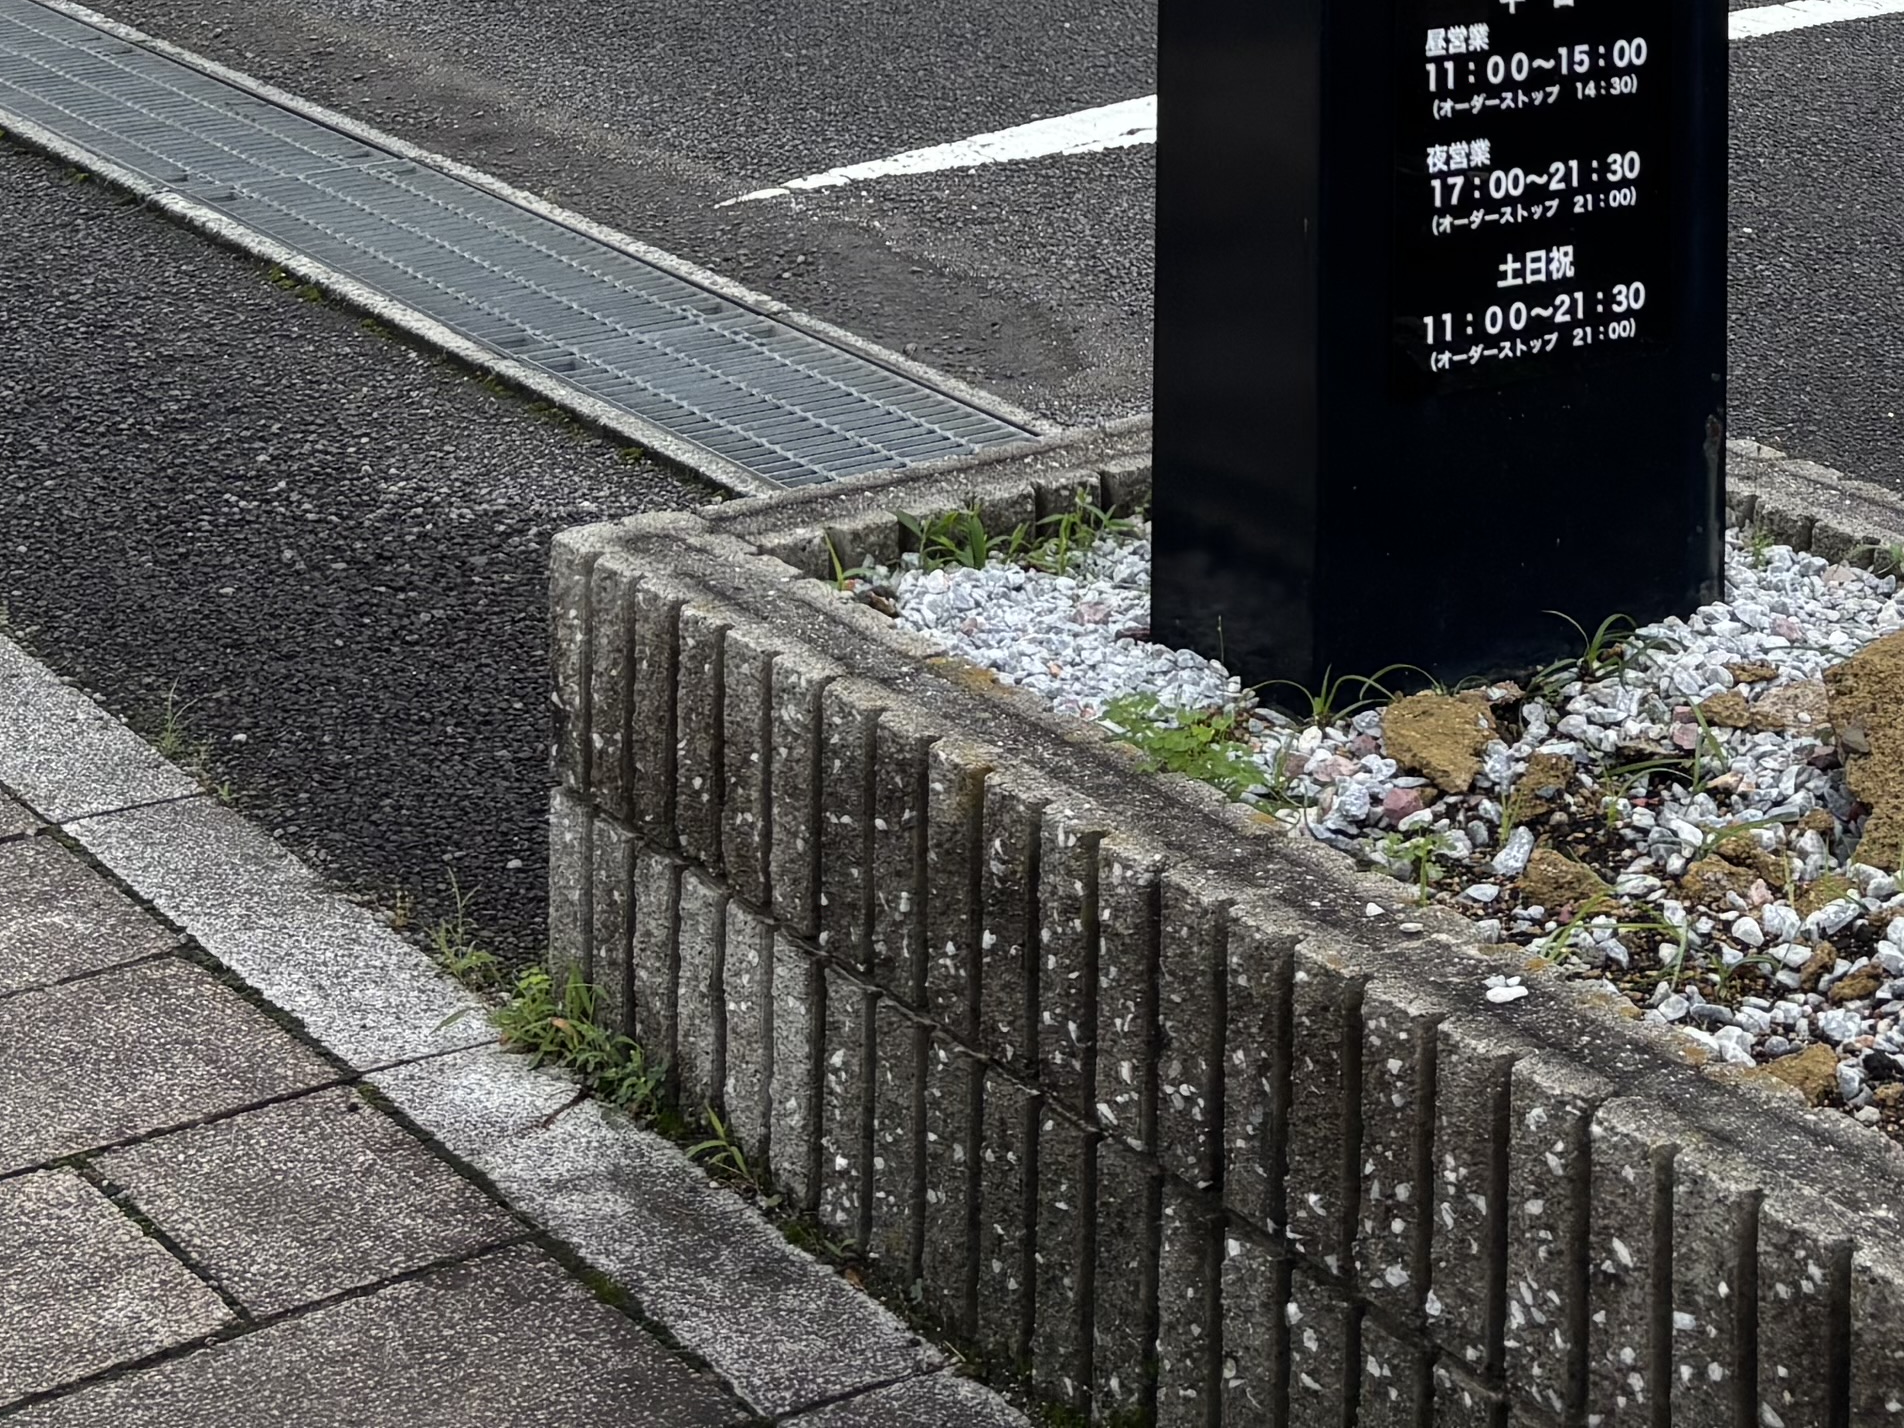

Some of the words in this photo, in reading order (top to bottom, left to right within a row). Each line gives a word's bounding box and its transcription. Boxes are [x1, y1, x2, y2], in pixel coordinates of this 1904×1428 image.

[1425, 22, 1490, 57] 昼営業
[1426, 138, 1492, 174] 夜営業
[1496, 245, 1576, 288] 土日祝
